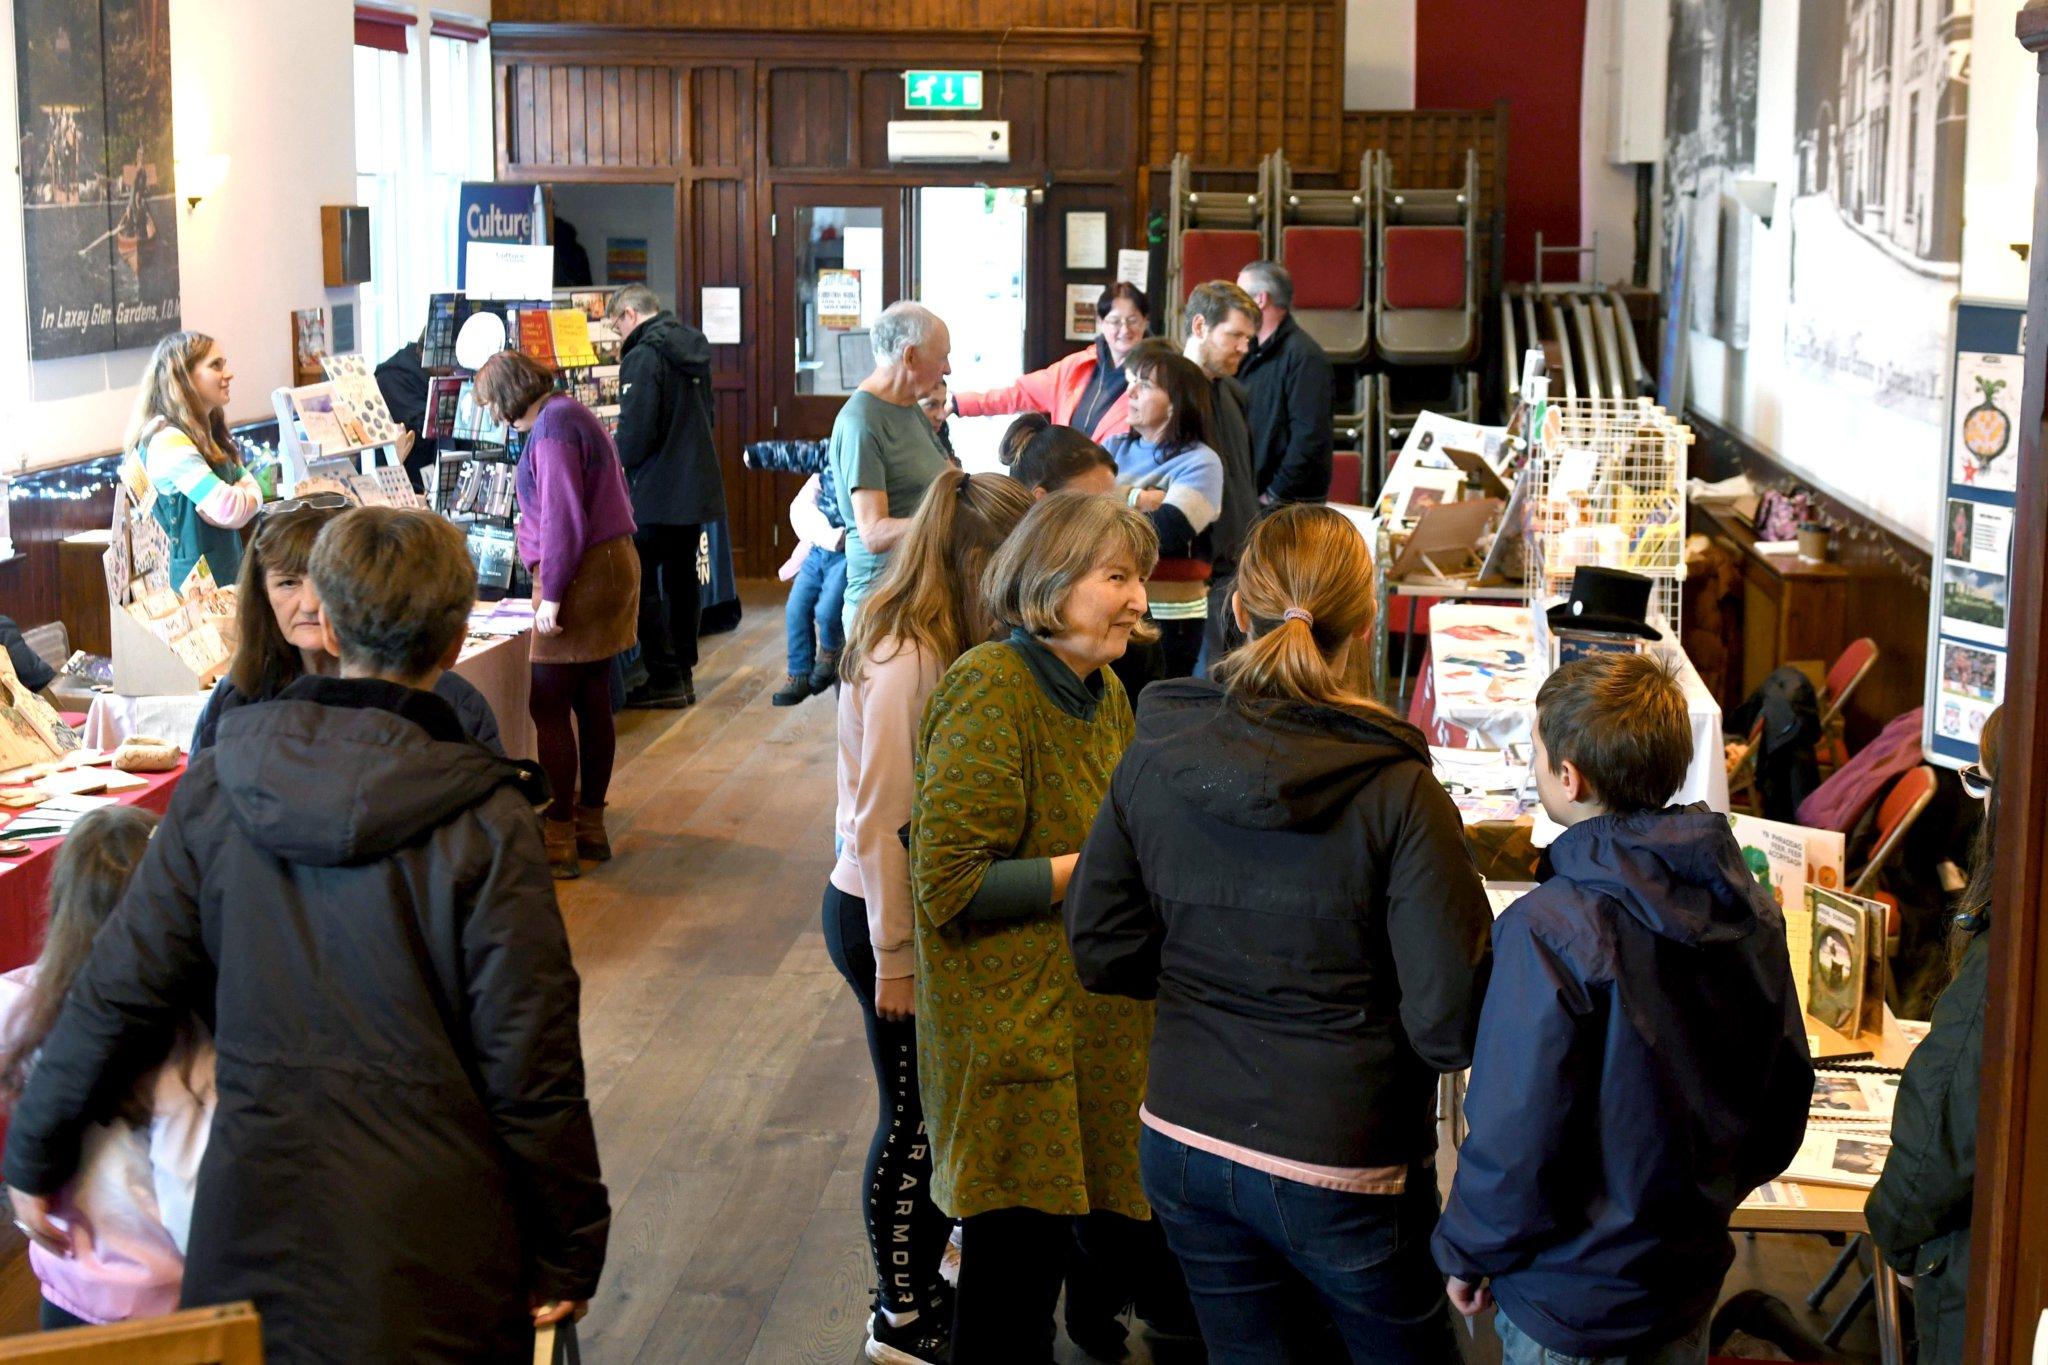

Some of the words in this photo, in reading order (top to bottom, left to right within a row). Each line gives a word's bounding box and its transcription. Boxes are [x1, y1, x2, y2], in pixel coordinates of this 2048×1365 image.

[467, 203, 530, 239] Culture
[40, 306, 55, 330] In
[57, 305, 90, 334] Laxey
[91, 302, 112, 326] Glen
[115, 301, 160, 325] Gardens,
[871, 1045, 907, 1206] PERFORMANCE
[892, 1172, 918, 1303] ARMOUR
